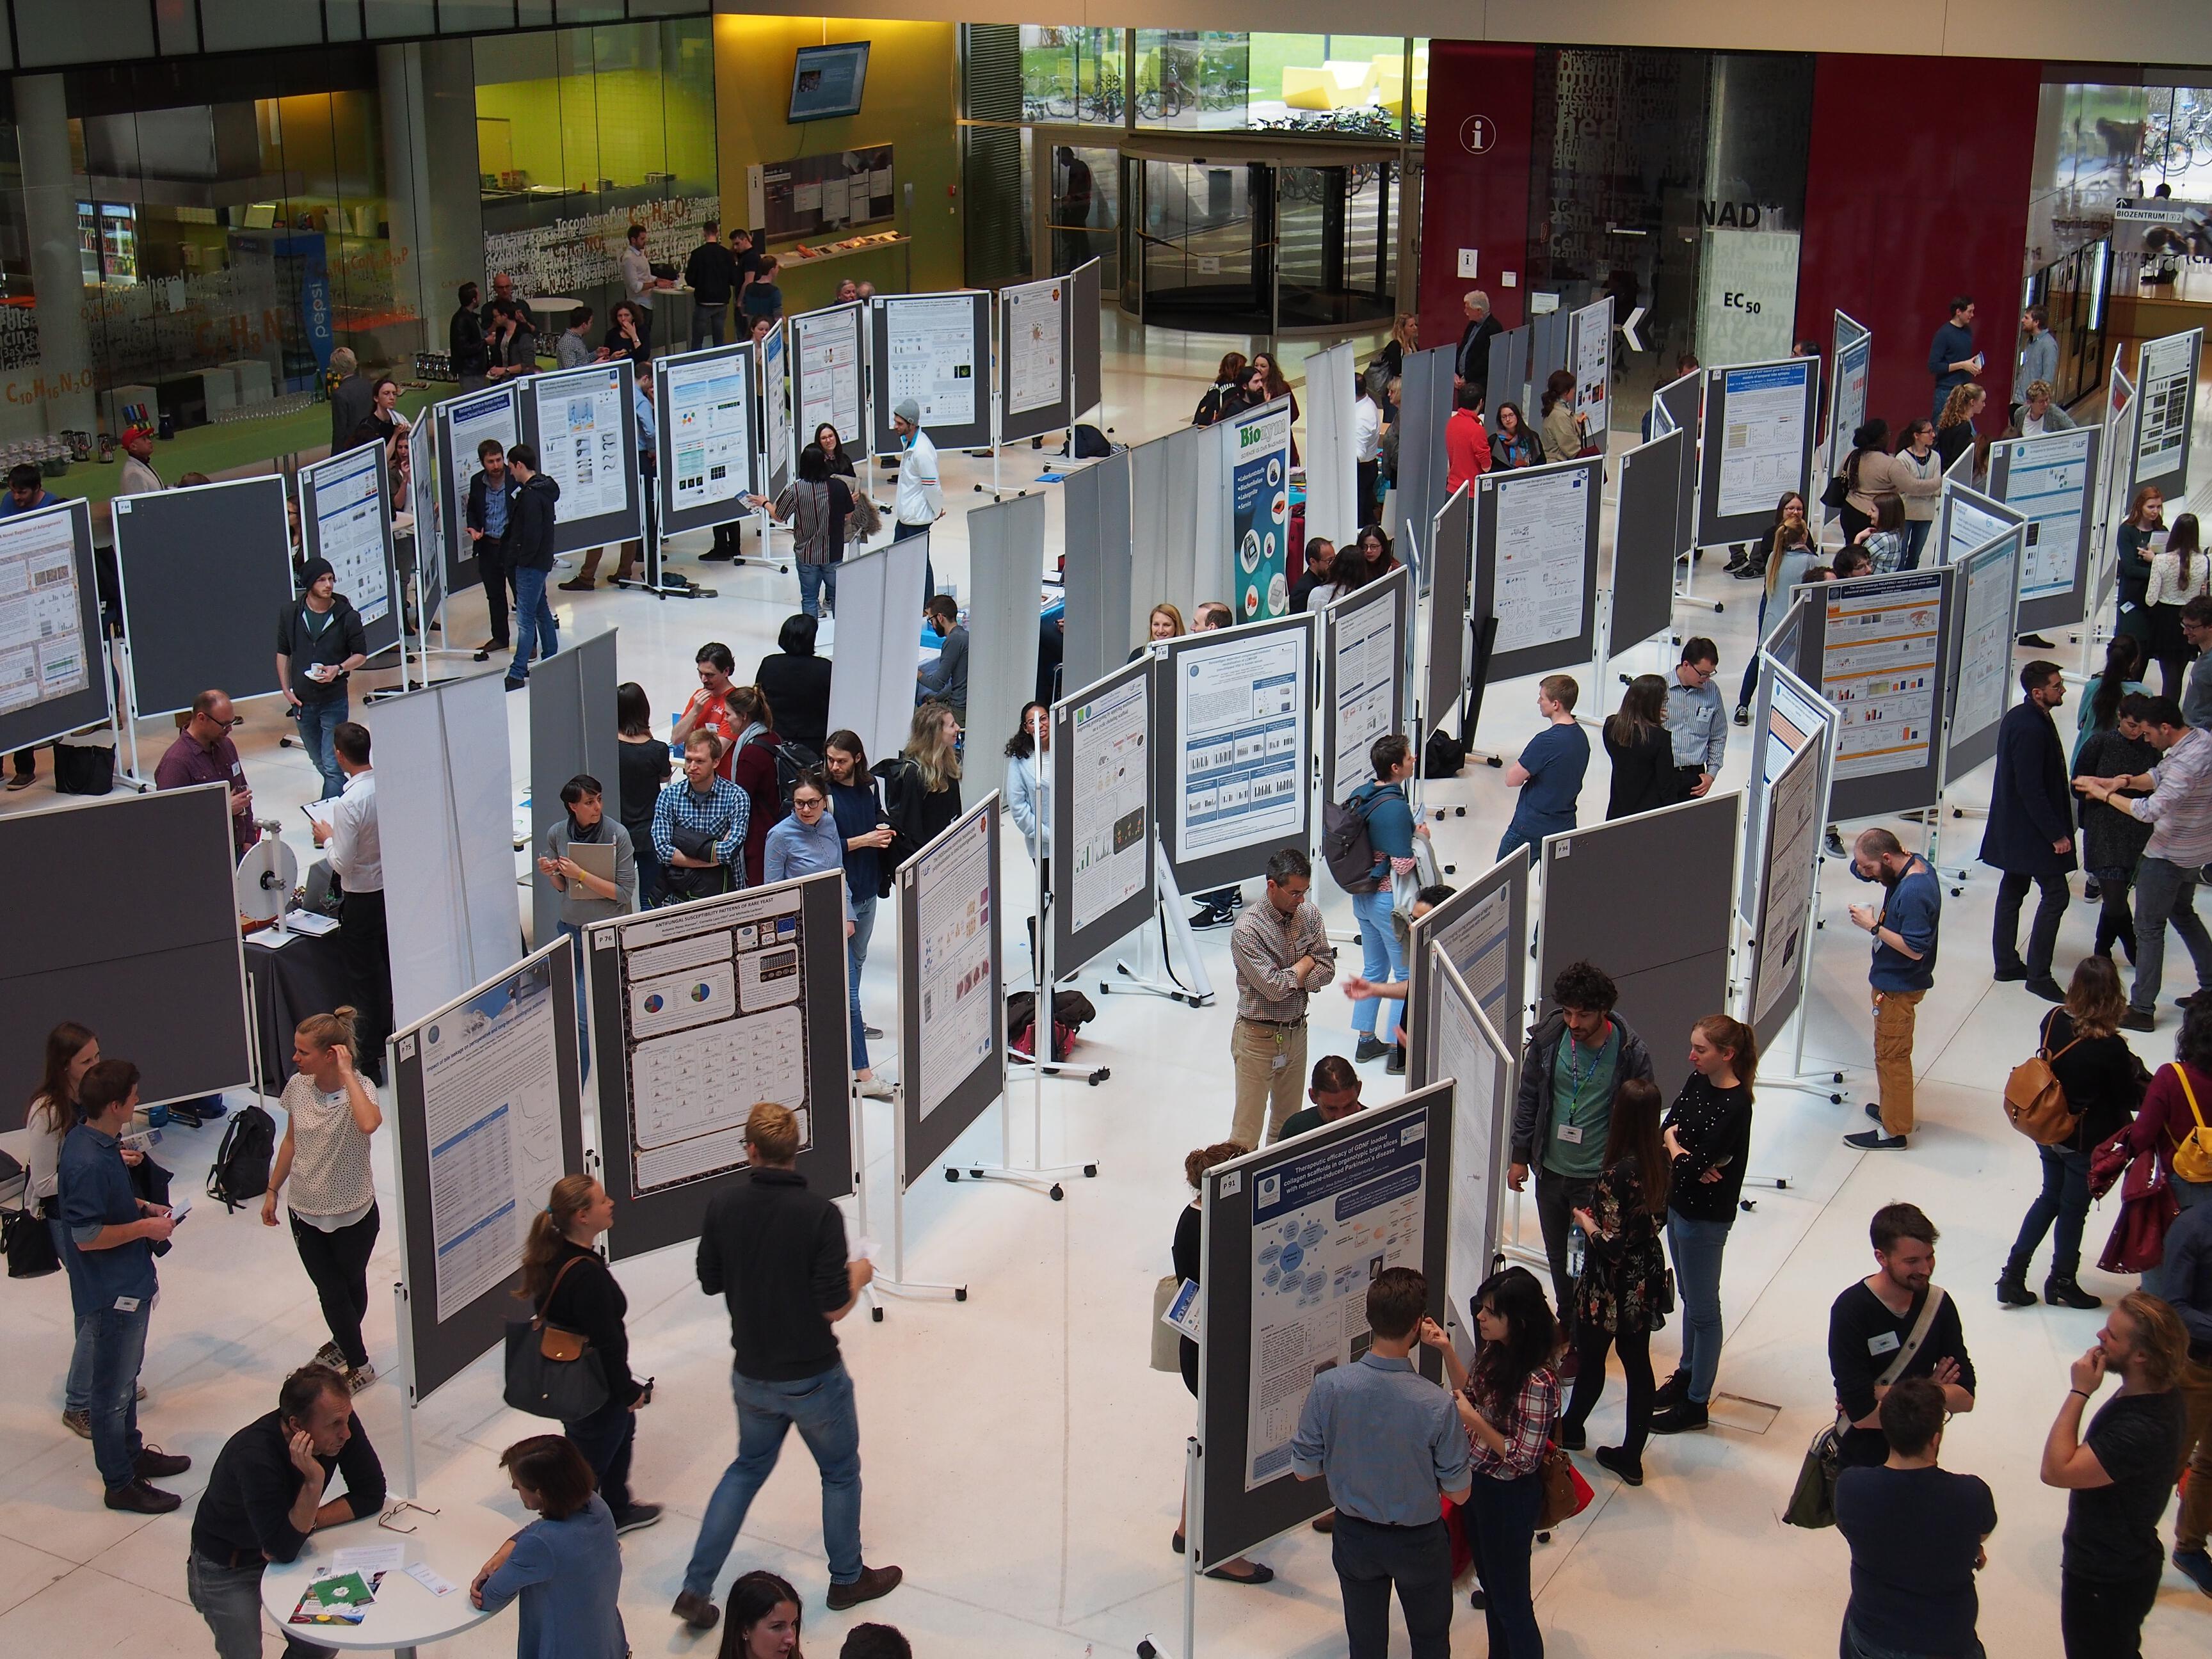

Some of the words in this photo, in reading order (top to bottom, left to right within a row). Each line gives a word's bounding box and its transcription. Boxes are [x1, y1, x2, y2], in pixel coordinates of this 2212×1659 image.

[2116, 210, 2166, 223] BIOZENTRUM
[309, 282, 329, 338] pepsi
[1240, 419, 1285, 448] Biozym
[655, 918, 684, 927] ANTIFUNGAL
[684, 911, 717, 921] SUSCEPTIBILITY
[719, 906, 740, 914] PATTERNS
[427, 1061, 439, 1071] Impact
[451, 1046, 464, 1057] leakage
[469, 1031, 490, 1048] perioperative
[498, 1018, 513, 1030] long-term
[514, 1007, 531, 1020] oncological
[532, 999, 545, 1010] outcome
[1284, 1174, 1306, 1187] collagen
[1307, 1166, 1331, 1178] scaffolds
[1338, 1151, 1368, 1167] organotypic
[1369, 1145, 1382, 1155] brain
[1382, 1140, 1398, 1150] slices
[1286, 1183, 1297, 1193] with
[1299, 1166, 1343, 1189] rotenone-induced
[1375, 1147, 1395, 1159] disease
[1295, 1158, 1327, 1174] Therapeutic
[1327, 1149, 1350, 1162] efficacy
[1356, 1141, 1371, 1151] GDNF
[1373, 1134, 1390, 1145] loaded
[1262, 1222, 1278, 1231] Background
